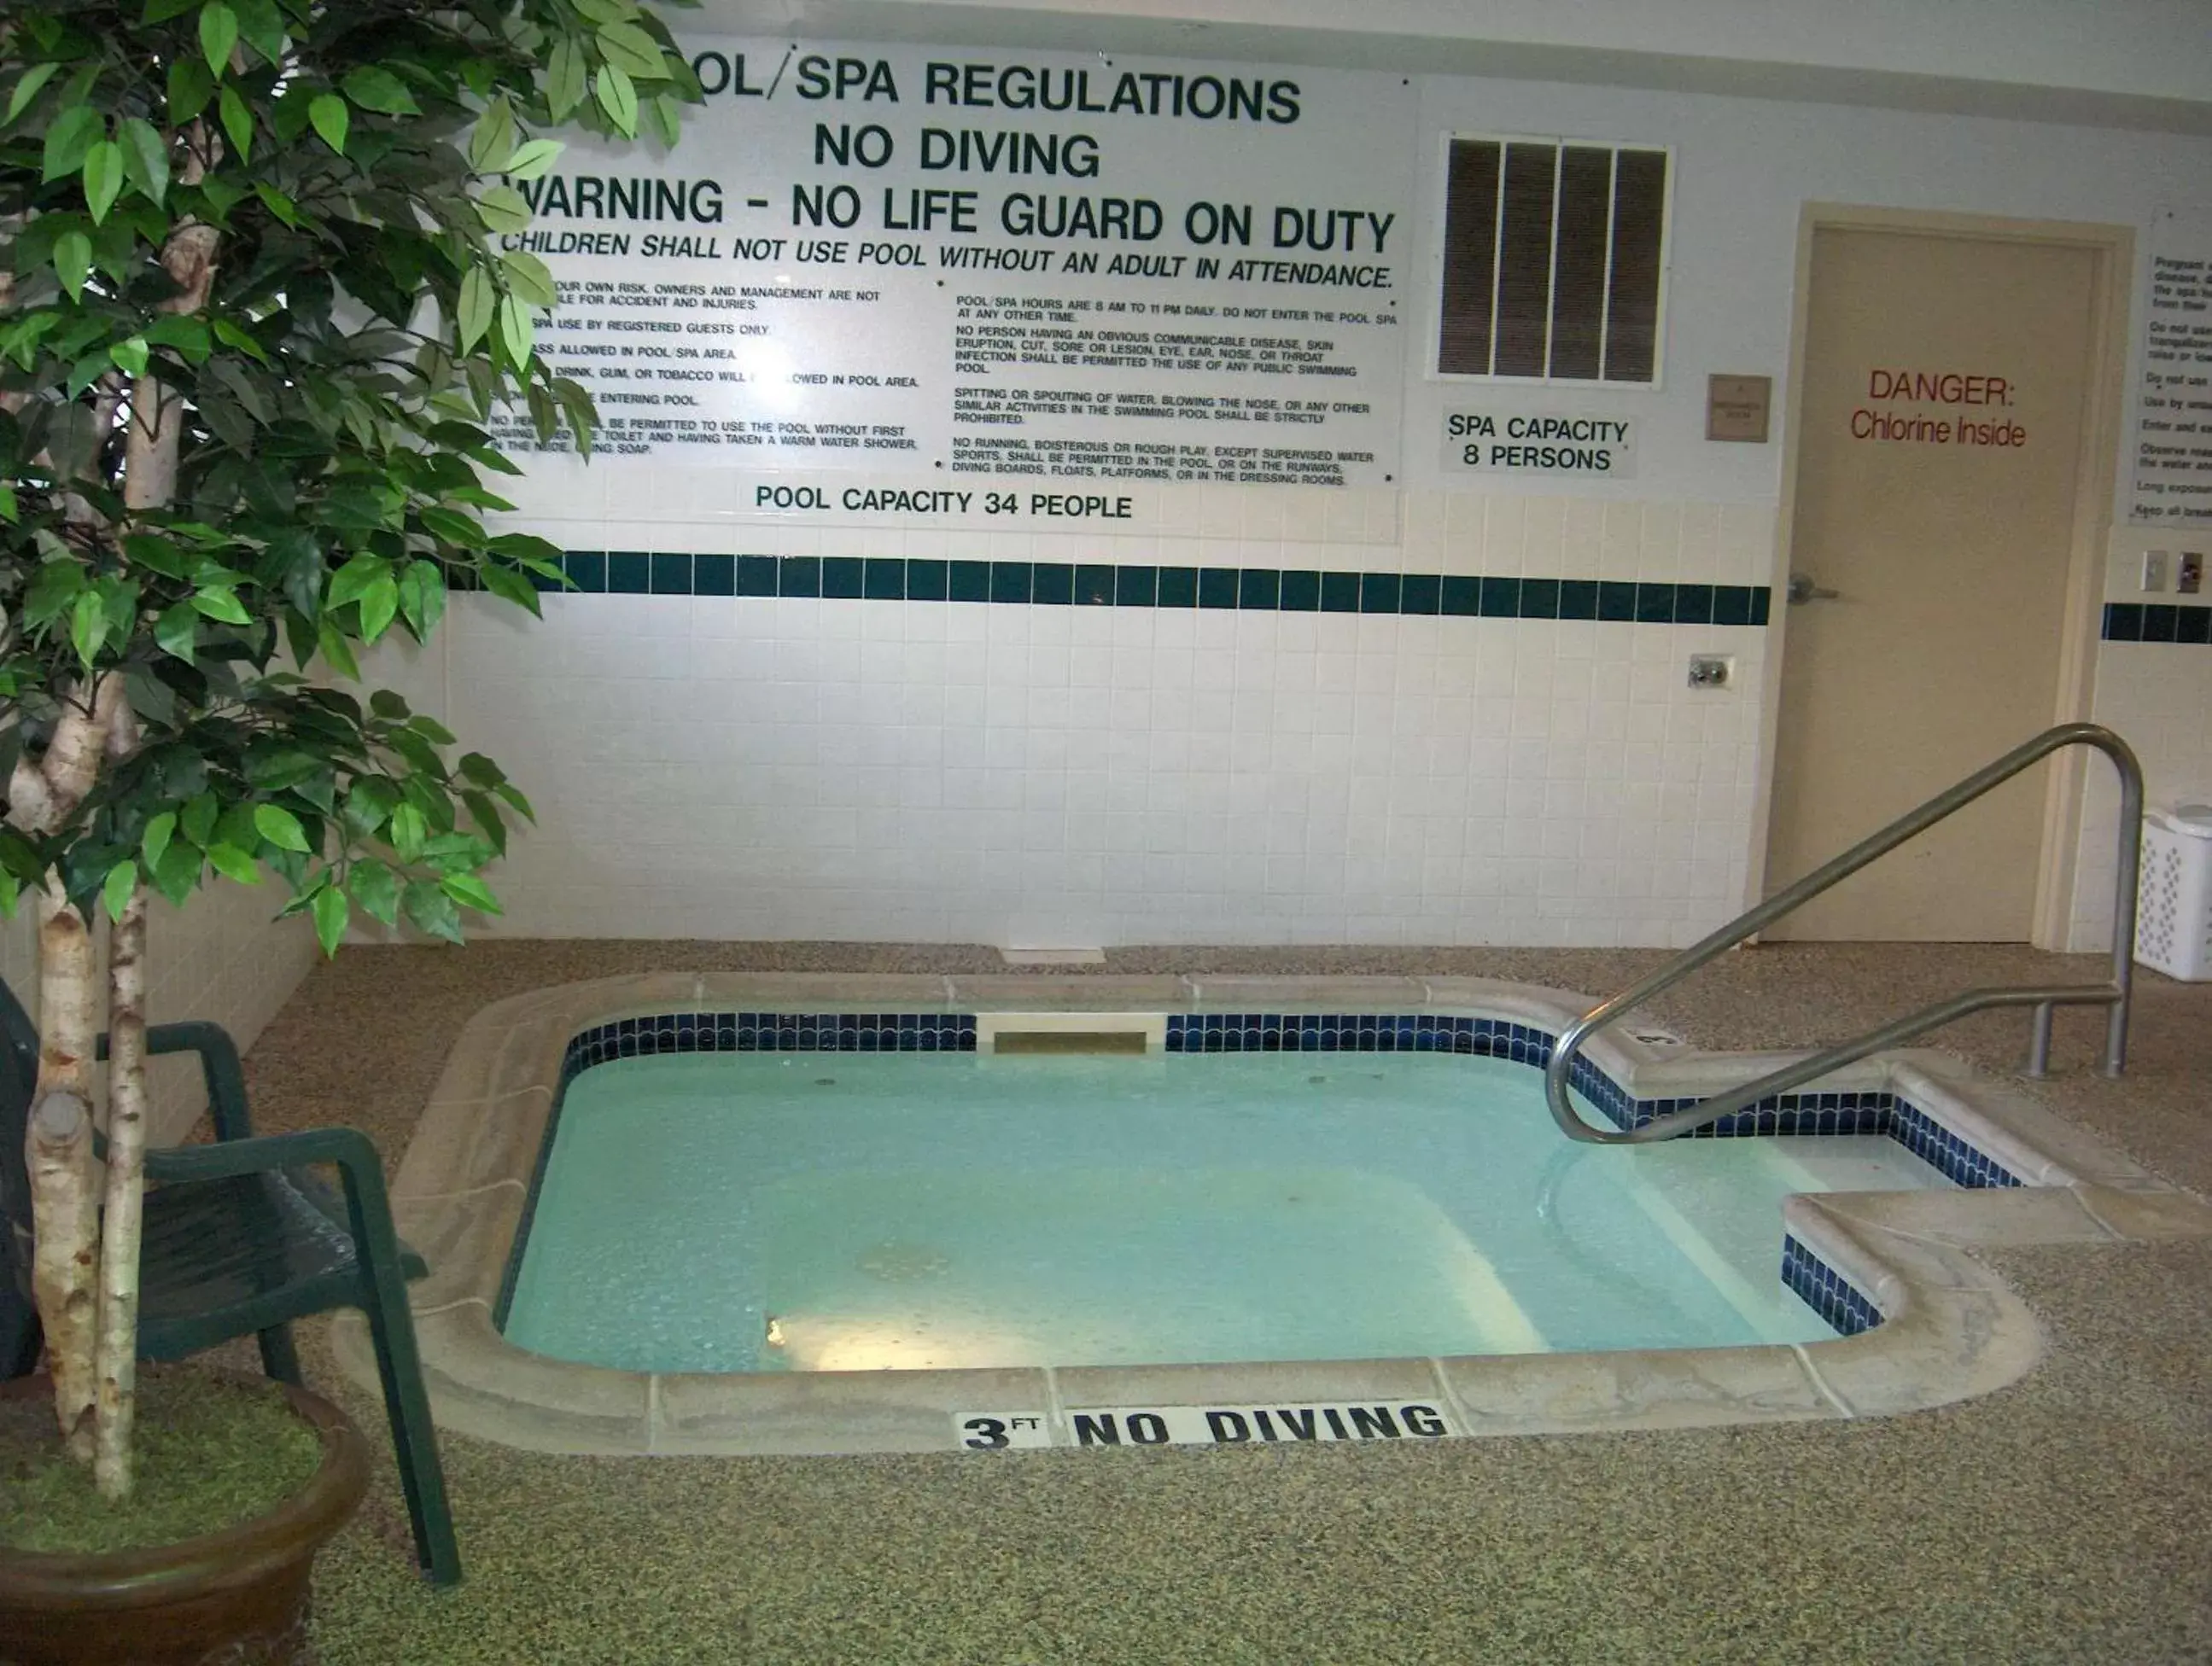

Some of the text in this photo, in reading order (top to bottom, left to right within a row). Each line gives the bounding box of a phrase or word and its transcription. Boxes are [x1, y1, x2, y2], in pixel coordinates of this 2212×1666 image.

[691, 44, 1301, 124] OL/SPA REGULATIONS
[815, 123, 1100, 177] NO DIVING
[793, 185, 861, 228] NO
[883, 188, 978, 232] LIFE
[1001, 193, 1162, 241] GUARD
[1186, 201, 1252, 246] ON
[1275, 207, 1395, 253] DUTY
[501, 233, 1392, 288] CHILDREN SHALL NOT USE POOL WITHOUT AN ADULT IN ATTENDANCE.
[580, 294, 604, 305] FOR
[610, 295, 667, 306] ACCIDENT
[673, 297, 697, 307] AND
[586, 283, 880, 301] OWN OWNERS AND MANAGEMENT ARE NOT
[958, 309, 1042, 320] AT ANY OTHER
[1022, 298, 1062, 309] HOURS
[1068, 300, 1090, 310] ARE
[1095, 300, 1103, 310] 8
[1108, 301, 1125, 312] AM
[1131, 303, 1145, 313] TO
[1164, 304, 1180, 315] PM
[1223, 307, 1240, 317] DO
[1245, 308, 1268, 318] NOT
[1272, 309, 1309, 320] ENTER
[1314, 311, 1334, 322] THE
[558, 318, 733, 334] USE BY REGISTERED GUESTS
[956, 326, 973, 335] NO
[978, 327, 1025, 337] PERSON
[1030, 328, 1072, 339] HAVING
[1077, 330, 1093, 340] AN
[1098, 330, 1148, 342] OBVIOUS
[1154, 333, 1246, 347] COMMUNICABLE
[560, 346, 616, 356] ALLOWED
[622, 347, 633, 357] IN
[1053, 341, 1084, 352] SORE
[1089, 342, 1106, 352] OR
[955, 351, 1357, 376] INFECTION SHALL BE PERMITTED THE USE OF ANY PUBLIC SWIMMING
[635, 370, 652, 380] OR
[658, 371, 714, 381] TOBACCO
[832, 374, 844, 385] IN
[849, 376, 881, 386] POOL
[1870, 370, 2014, 406] DANGER:
[600, 394, 659, 405] ENTERING
[954, 387, 1369, 413] SPITTING SPOUTING BLOWING THE ANY OTHER
[954, 400, 1325, 423] SIMILAR ACTIVITIES THE SWIMMING POOL SHALL BE STRICTLY
[610, 419, 625, 428] BE
[630, 420, 696, 430] PERMITTED
[702, 422, 716, 431] TO
[721, 423, 744, 432] USE
[751, 423, 772, 433] THE
[778, 424, 809, 434] POOL
[815, 425, 866, 434] WITHOUT
[873, 426, 905, 435] FIRST
[1449, 414, 1628, 442] SPA CAPACITY
[1852, 411, 2026, 447] Chlorine Inside
[605, 431, 643, 440] TOILET
[649, 432, 673, 441] AND
[678, 434, 720, 444] HAVING
[727, 435, 762, 446] TAKEN
[768, 436, 775, 445] A
[780, 437, 815, 446] WARM
[821, 438, 859, 447] WATER
[954, 438, 970, 447] NO
[1035, 440, 1108, 452] BOISTEROUS
[1135, 443, 1175, 454] ROUGH
[1215, 446, 1258, 458] EXCEPT
[1263, 449, 1332, 461] SUPERVISED
[1338, 451, 1374, 462] WATER
[1008, 451, 1281, 471] SHALL BE PERMITTED THE THE
[1463, 445, 1610, 470] 8 PERSONS
[953, 463, 990, 473] DIVING
[1240, 473, 1297, 484] DRESSING
[756, 486, 1132, 518] POOL CAPACITY 34 PEOPLE
[1074, 1413, 1170, 1446] NO
[1205, 1407, 1448, 1442] DIVING
